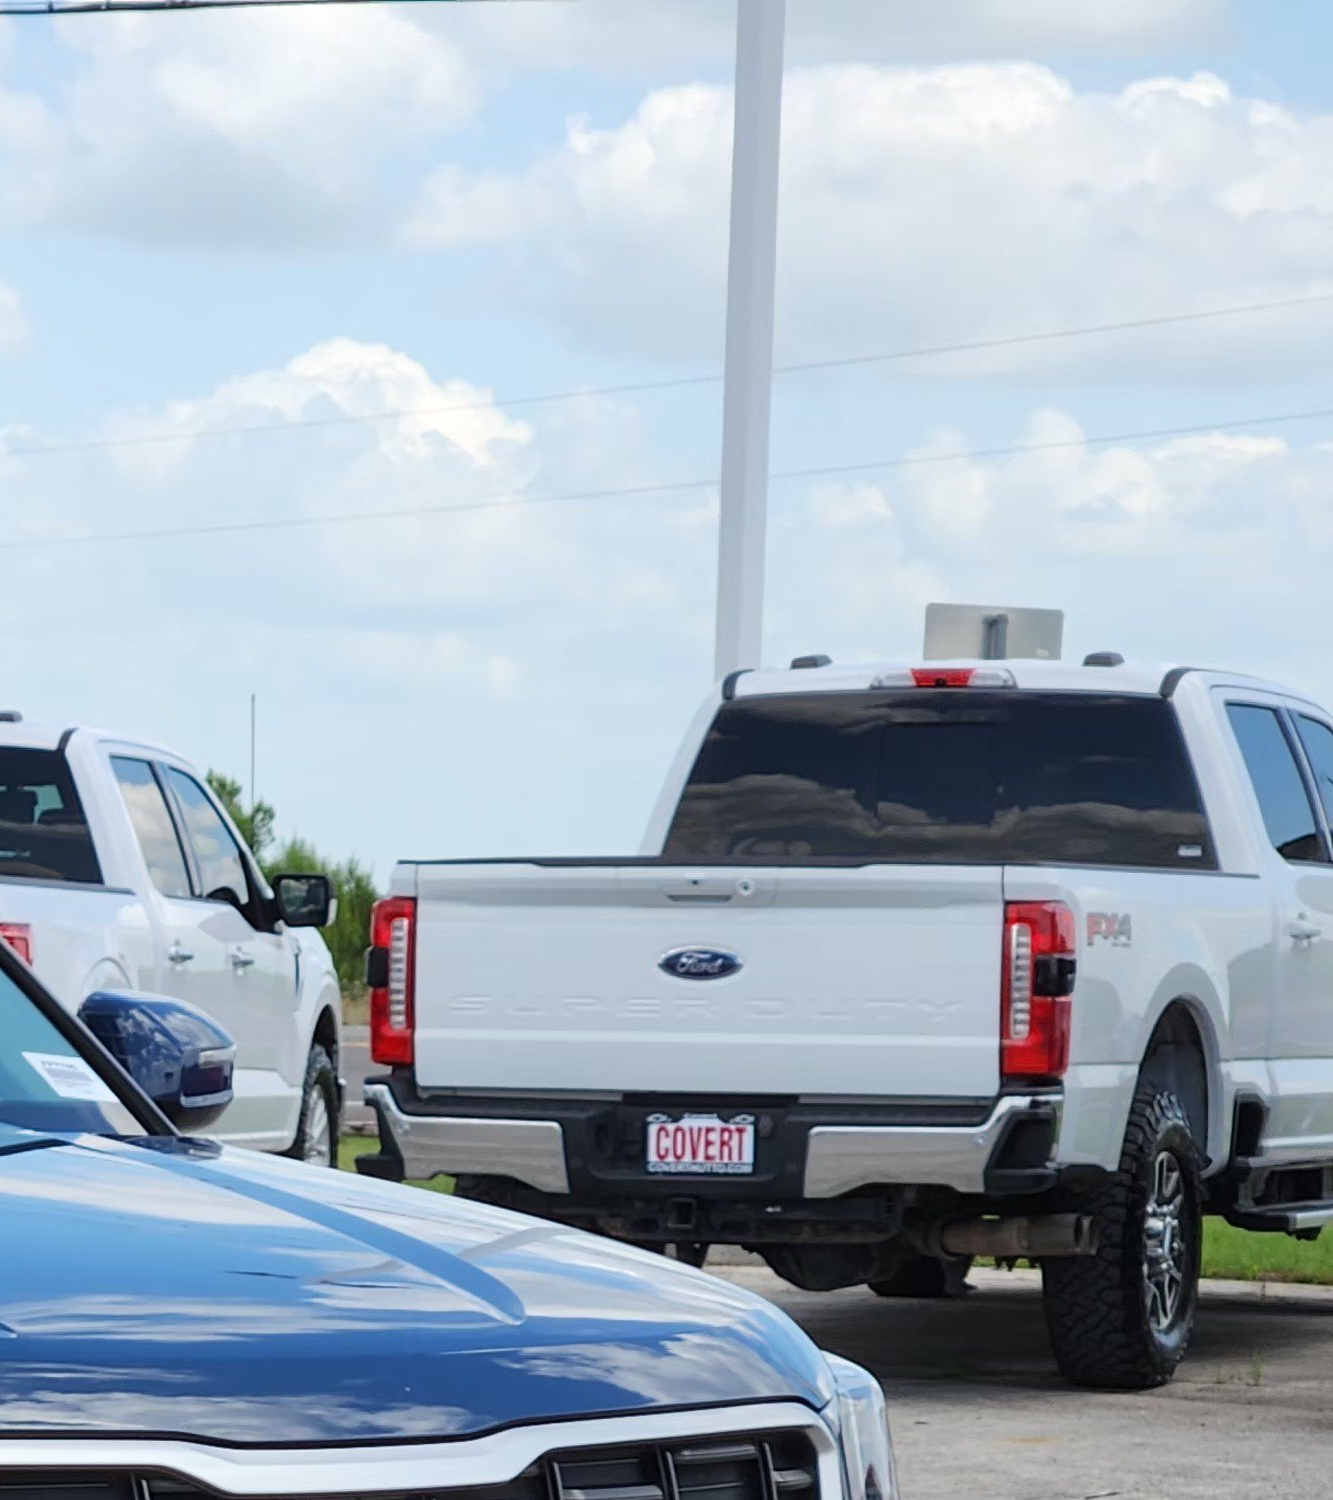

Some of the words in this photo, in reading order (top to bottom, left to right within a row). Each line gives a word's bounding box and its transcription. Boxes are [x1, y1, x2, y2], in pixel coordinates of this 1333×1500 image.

[1087, 912, 1132, 946] FX4
[676, 951, 724, 973] Ford
[446, 994, 719, 1020] SUPER
[743, 995, 967, 1023] DUTY
[656, 1125, 747, 1161] COVERT
